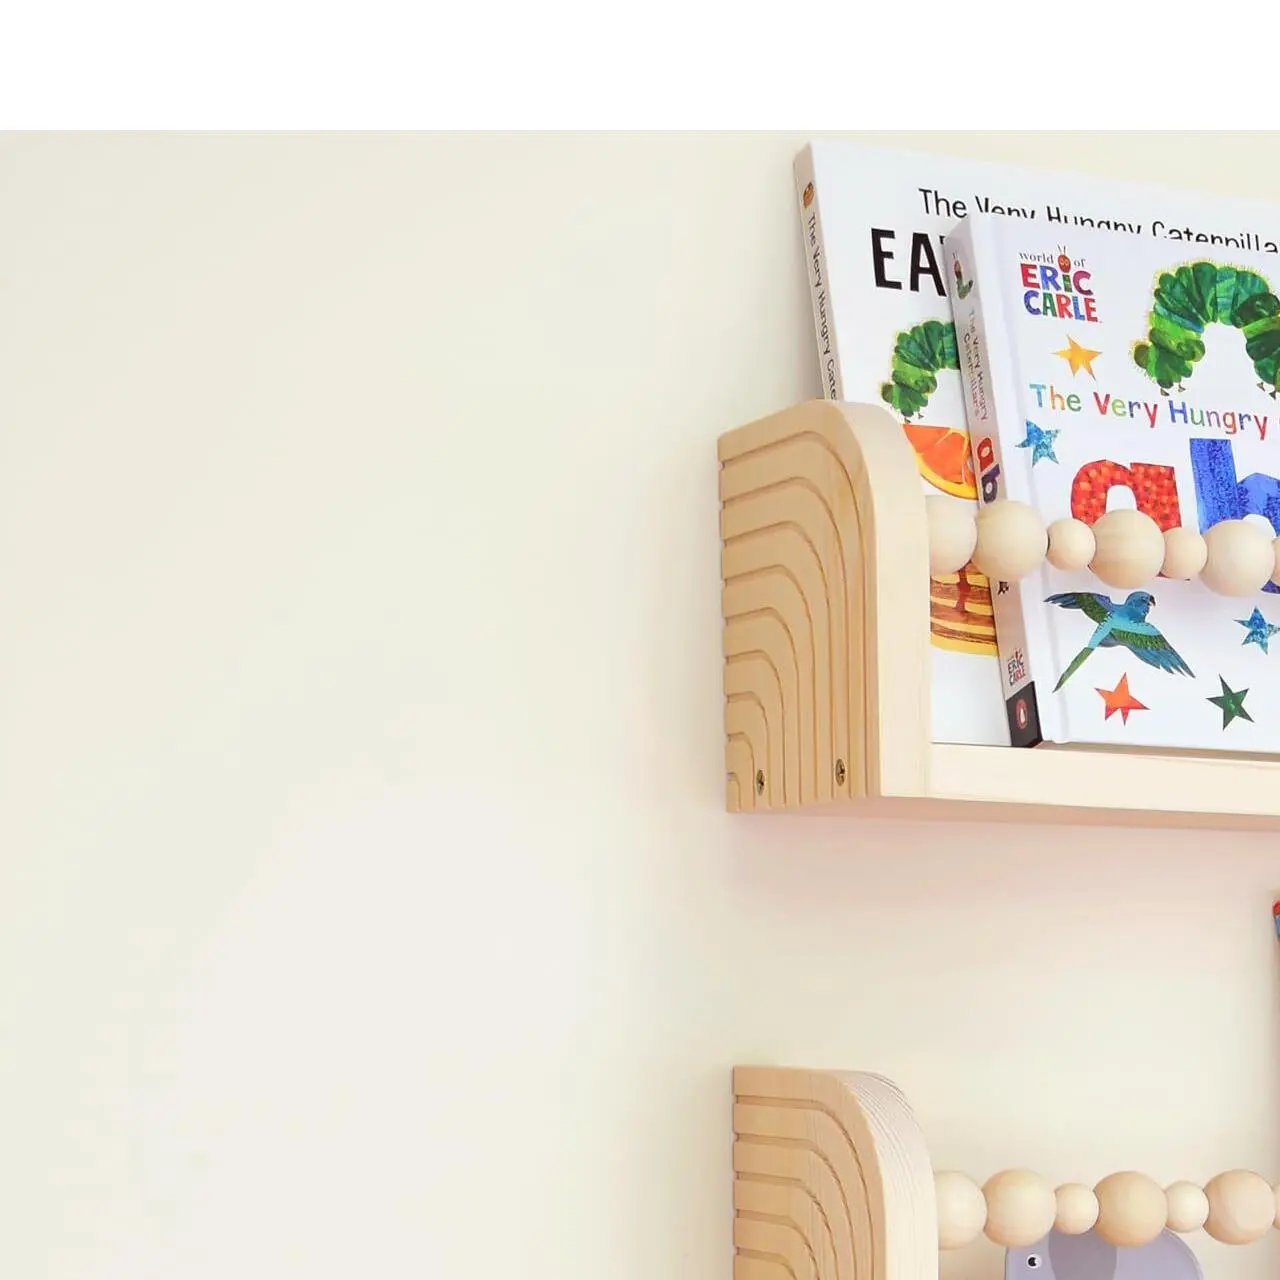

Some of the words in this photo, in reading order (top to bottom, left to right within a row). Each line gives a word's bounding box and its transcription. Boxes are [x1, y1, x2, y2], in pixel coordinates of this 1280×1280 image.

[918, 187, 968, 218] The
[807, 211, 817, 246] The
[811, 247, 823, 287] Very
[871, 227, 948, 298] EA
[1019, 252, 1054, 265] world
[1074, 258, 1087, 268] of
[817, 291, 831, 355] Hungry
[1023, 290, 1099, 323] CARLE
[826, 359, 838, 401] Cate
[1029, 383, 1083, 413] The
[1092, 391, 1159, 429] Very
[1167, 399, 1268, 441] Hungry
